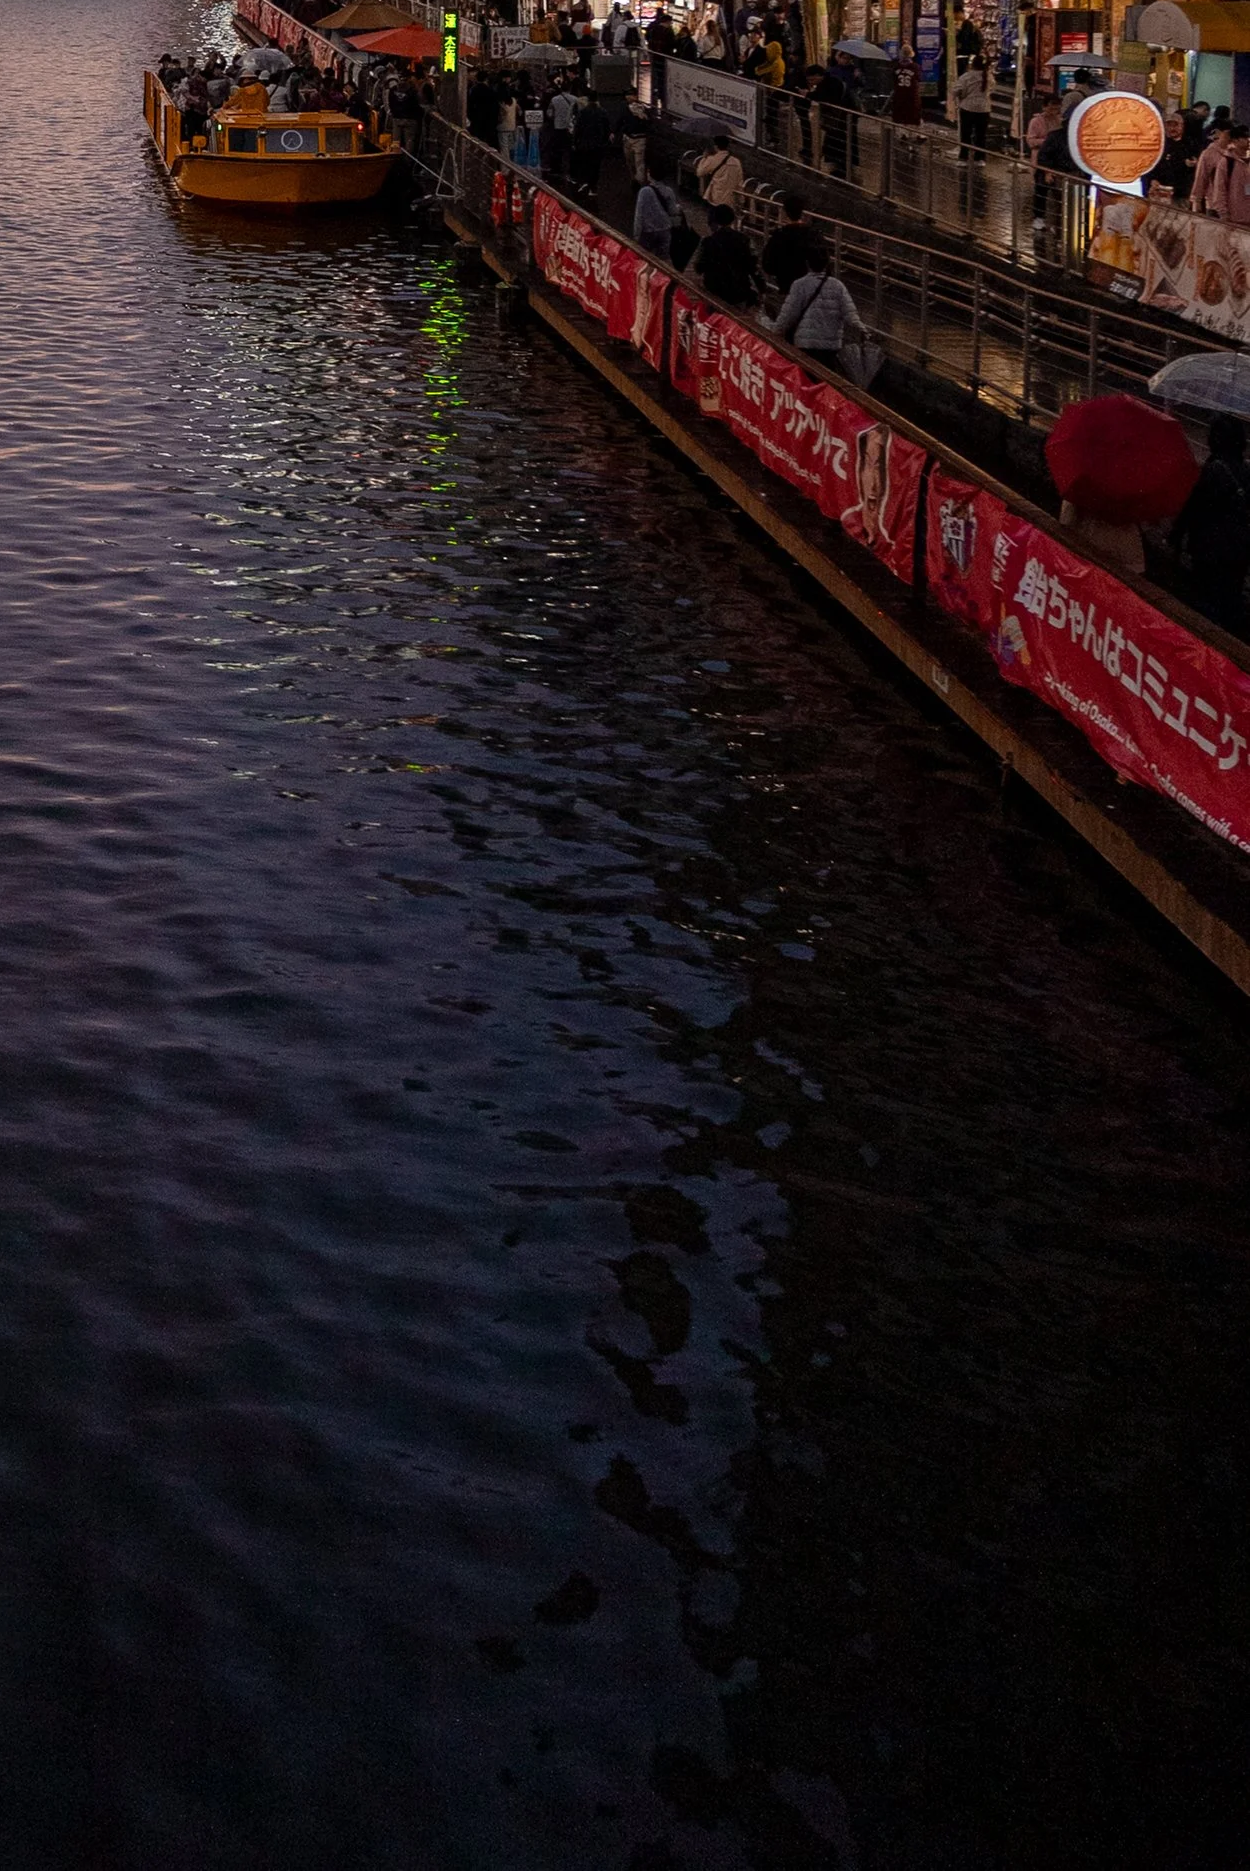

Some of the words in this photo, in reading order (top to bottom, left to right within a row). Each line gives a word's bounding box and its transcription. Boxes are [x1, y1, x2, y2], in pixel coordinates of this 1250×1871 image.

[1013, 557, 1250, 770] 飴ちゃんはコミュニケ
